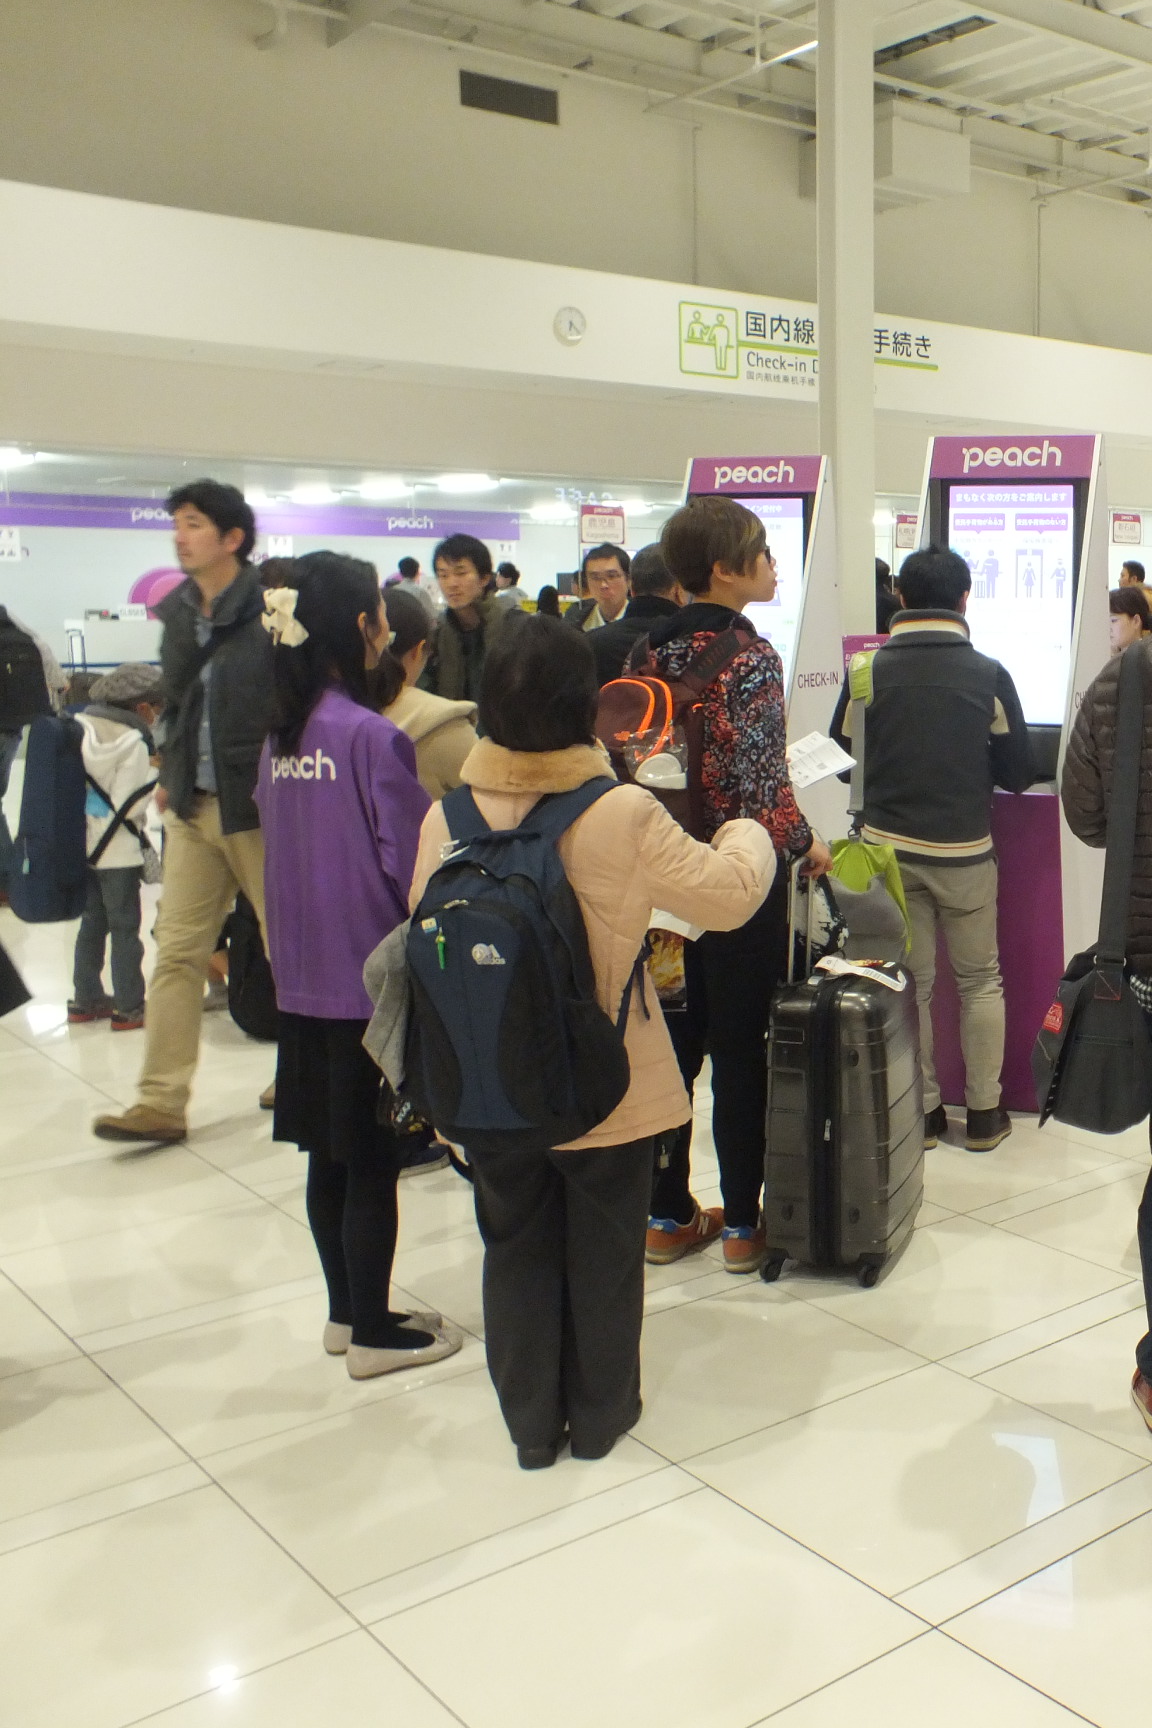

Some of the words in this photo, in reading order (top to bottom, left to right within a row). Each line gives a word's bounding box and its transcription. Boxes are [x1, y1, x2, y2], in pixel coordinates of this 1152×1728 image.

[745, 311, 815, 344] 国内線
[874, 328, 932, 359] 手続き
[746, 351, 807, 373] Check-in
[962, 440, 1062, 473] peach
[714, 460, 795, 489] peach
[955, 492, 1068, 503] まもなく次の方をご案内します
[386, 515, 434, 531] peach
[797, 671, 839, 689] CHECK-IN
[271, 748, 337, 785] peach
